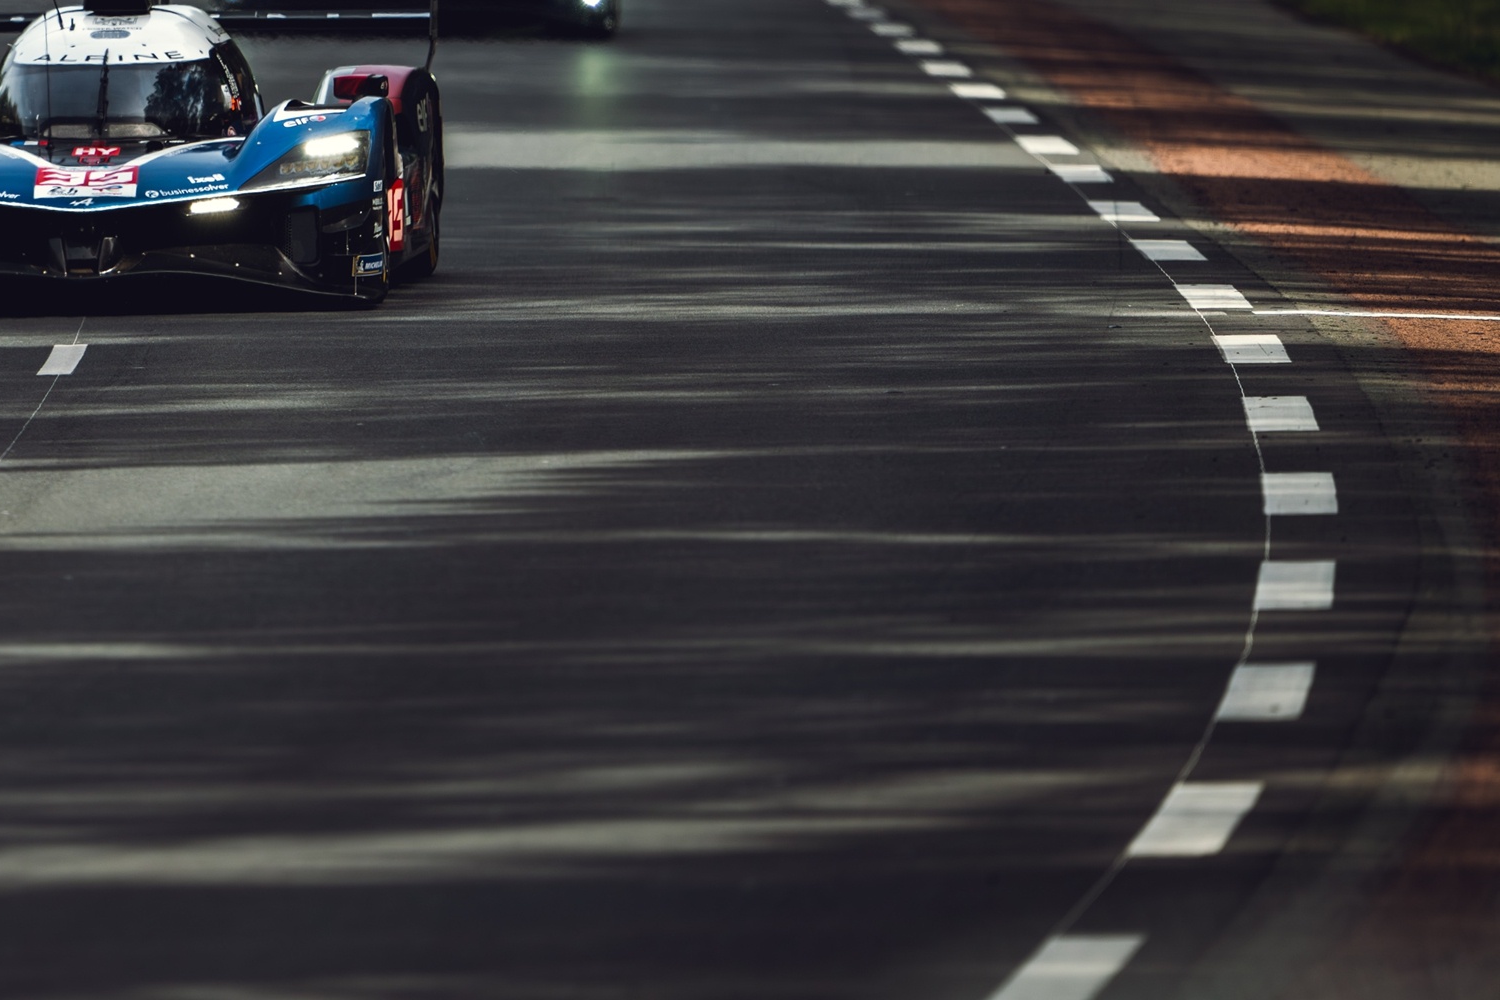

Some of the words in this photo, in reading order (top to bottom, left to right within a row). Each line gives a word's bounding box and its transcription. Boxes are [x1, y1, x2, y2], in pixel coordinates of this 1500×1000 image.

[33, 50, 185, 63] ALPINE
[75, 147, 119, 156] HY
[39, 167, 134, 187] 35
[160, 184, 229, 197] businessolver
